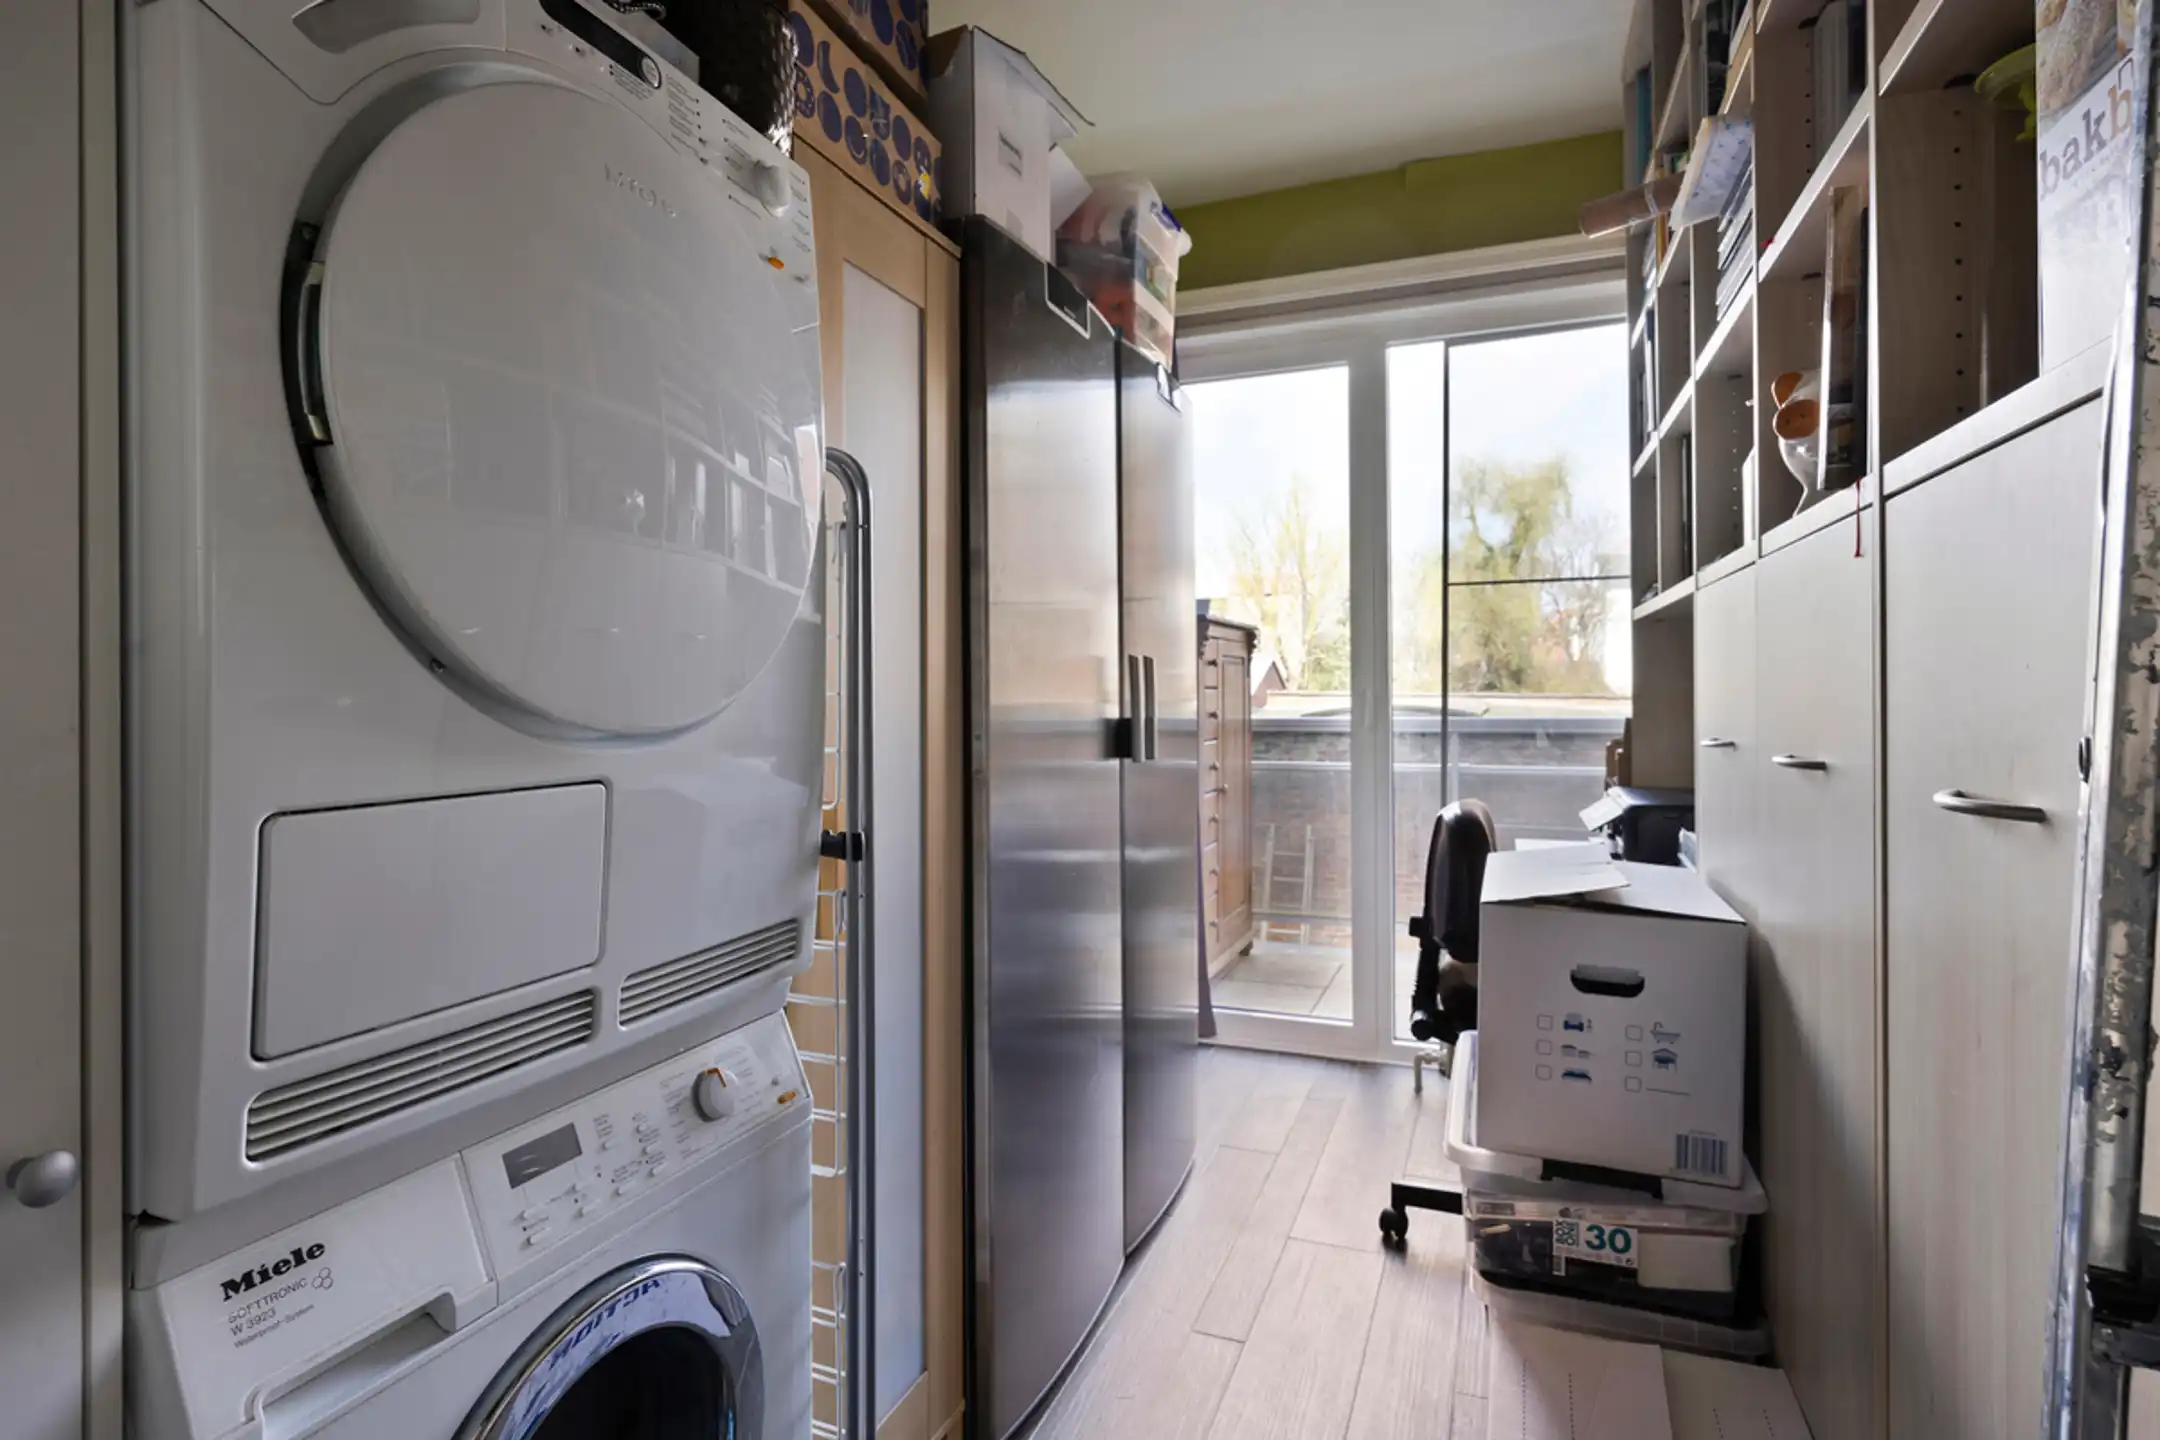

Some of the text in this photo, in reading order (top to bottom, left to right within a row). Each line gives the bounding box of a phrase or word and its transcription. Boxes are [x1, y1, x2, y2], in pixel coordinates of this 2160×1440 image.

[1585, 1224, 1632, 1254] 30
[220, 1243, 325, 1302] Miele
[228, 1277, 308, 1323] SOFTTRONIC
[230, 1323, 244, 1336] W
